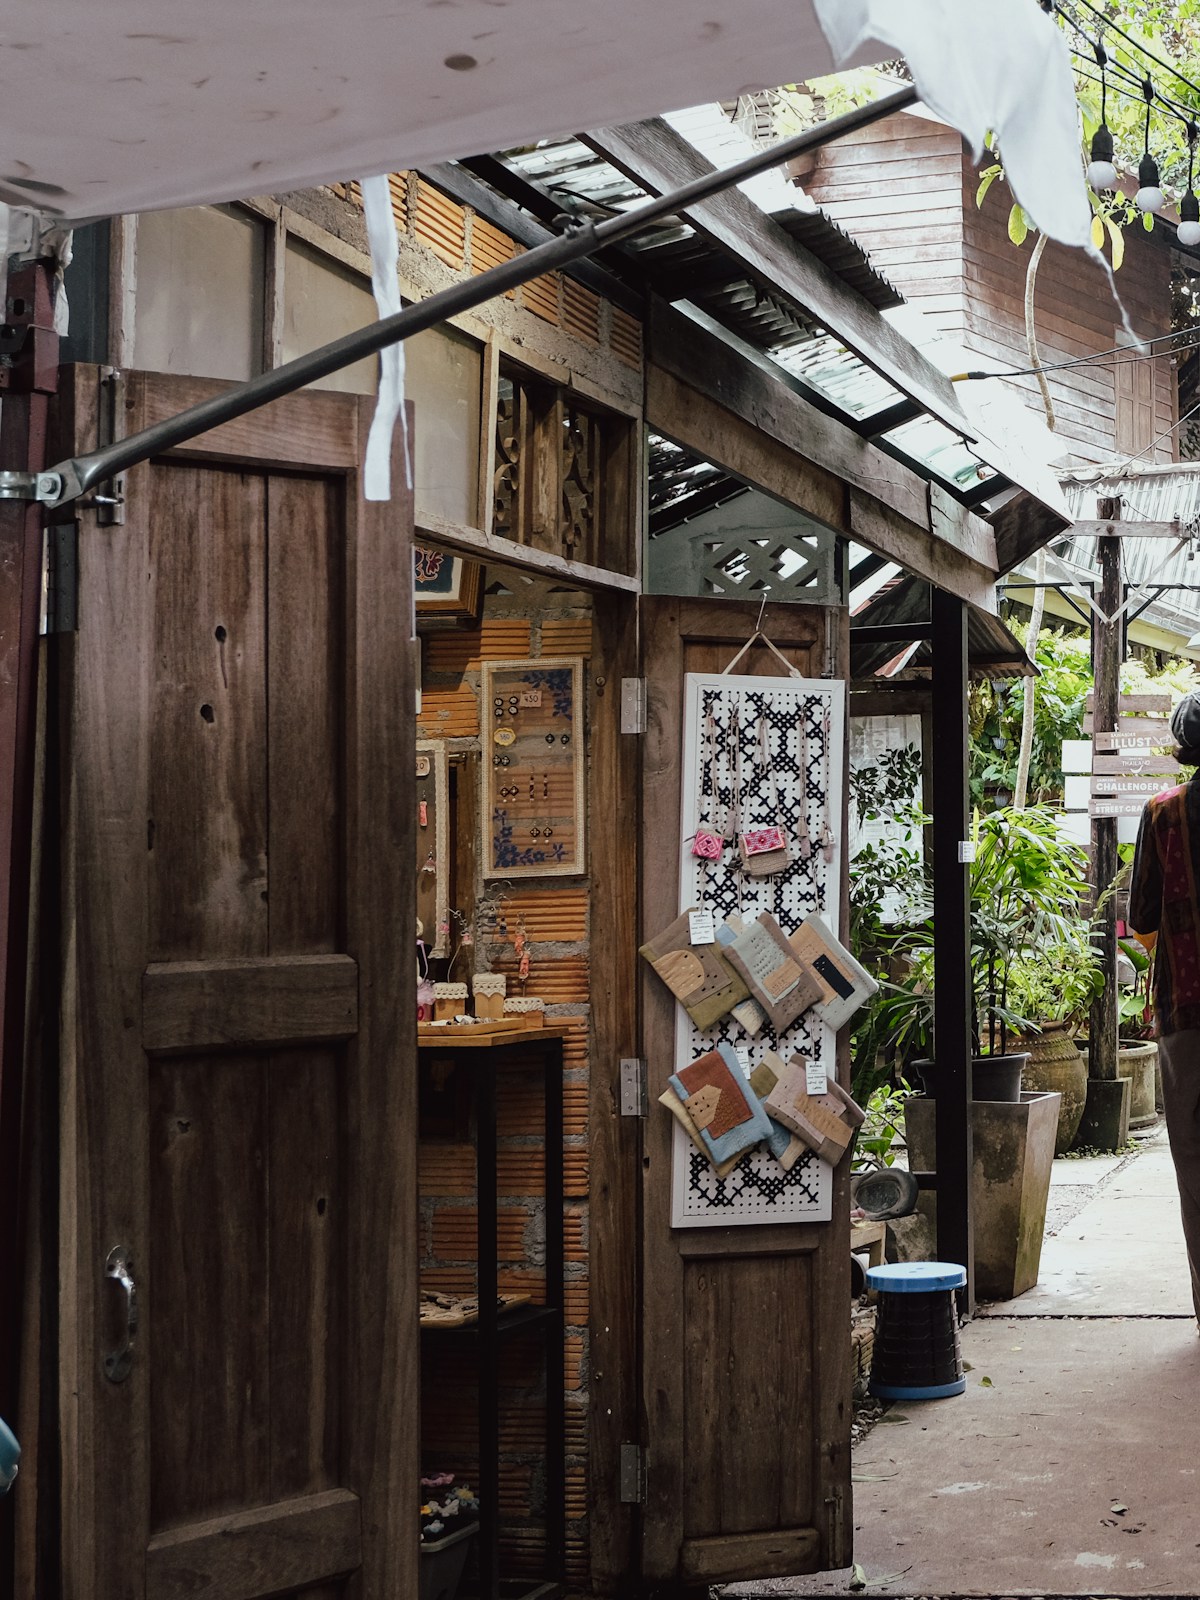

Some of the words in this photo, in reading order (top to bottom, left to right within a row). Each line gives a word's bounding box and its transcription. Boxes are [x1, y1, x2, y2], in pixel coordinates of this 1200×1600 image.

[1110, 737, 1151, 748] ILLUST
[1095, 782, 1159, 791] CHALLENGER
[1095, 805, 1123, 813] STREET
